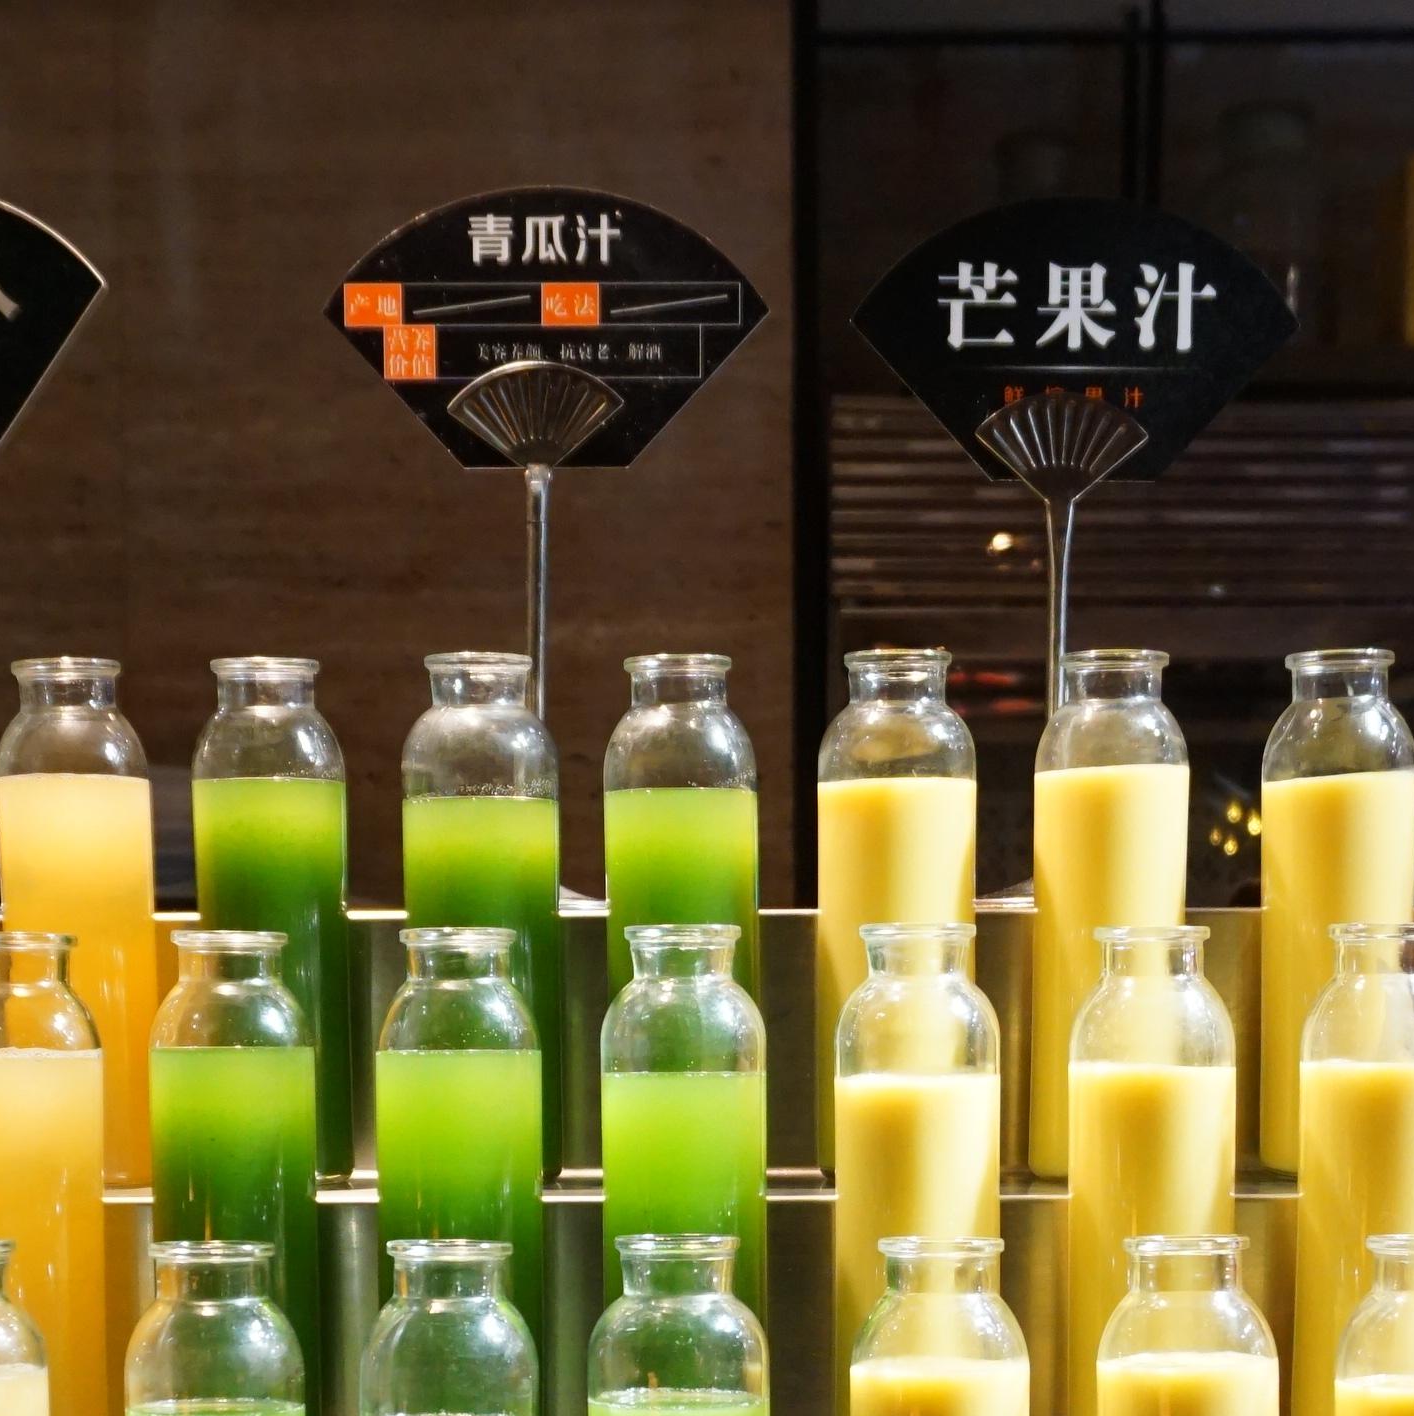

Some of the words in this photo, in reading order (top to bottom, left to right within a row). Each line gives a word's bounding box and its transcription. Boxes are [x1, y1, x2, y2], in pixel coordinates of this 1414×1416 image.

[467, 214, 621, 265] 青瓜汁
[349, 293, 398, 316] 产地
[545, 293, 595, 317] 吃法
[937, 262, 1217, 351] 芒果汁
